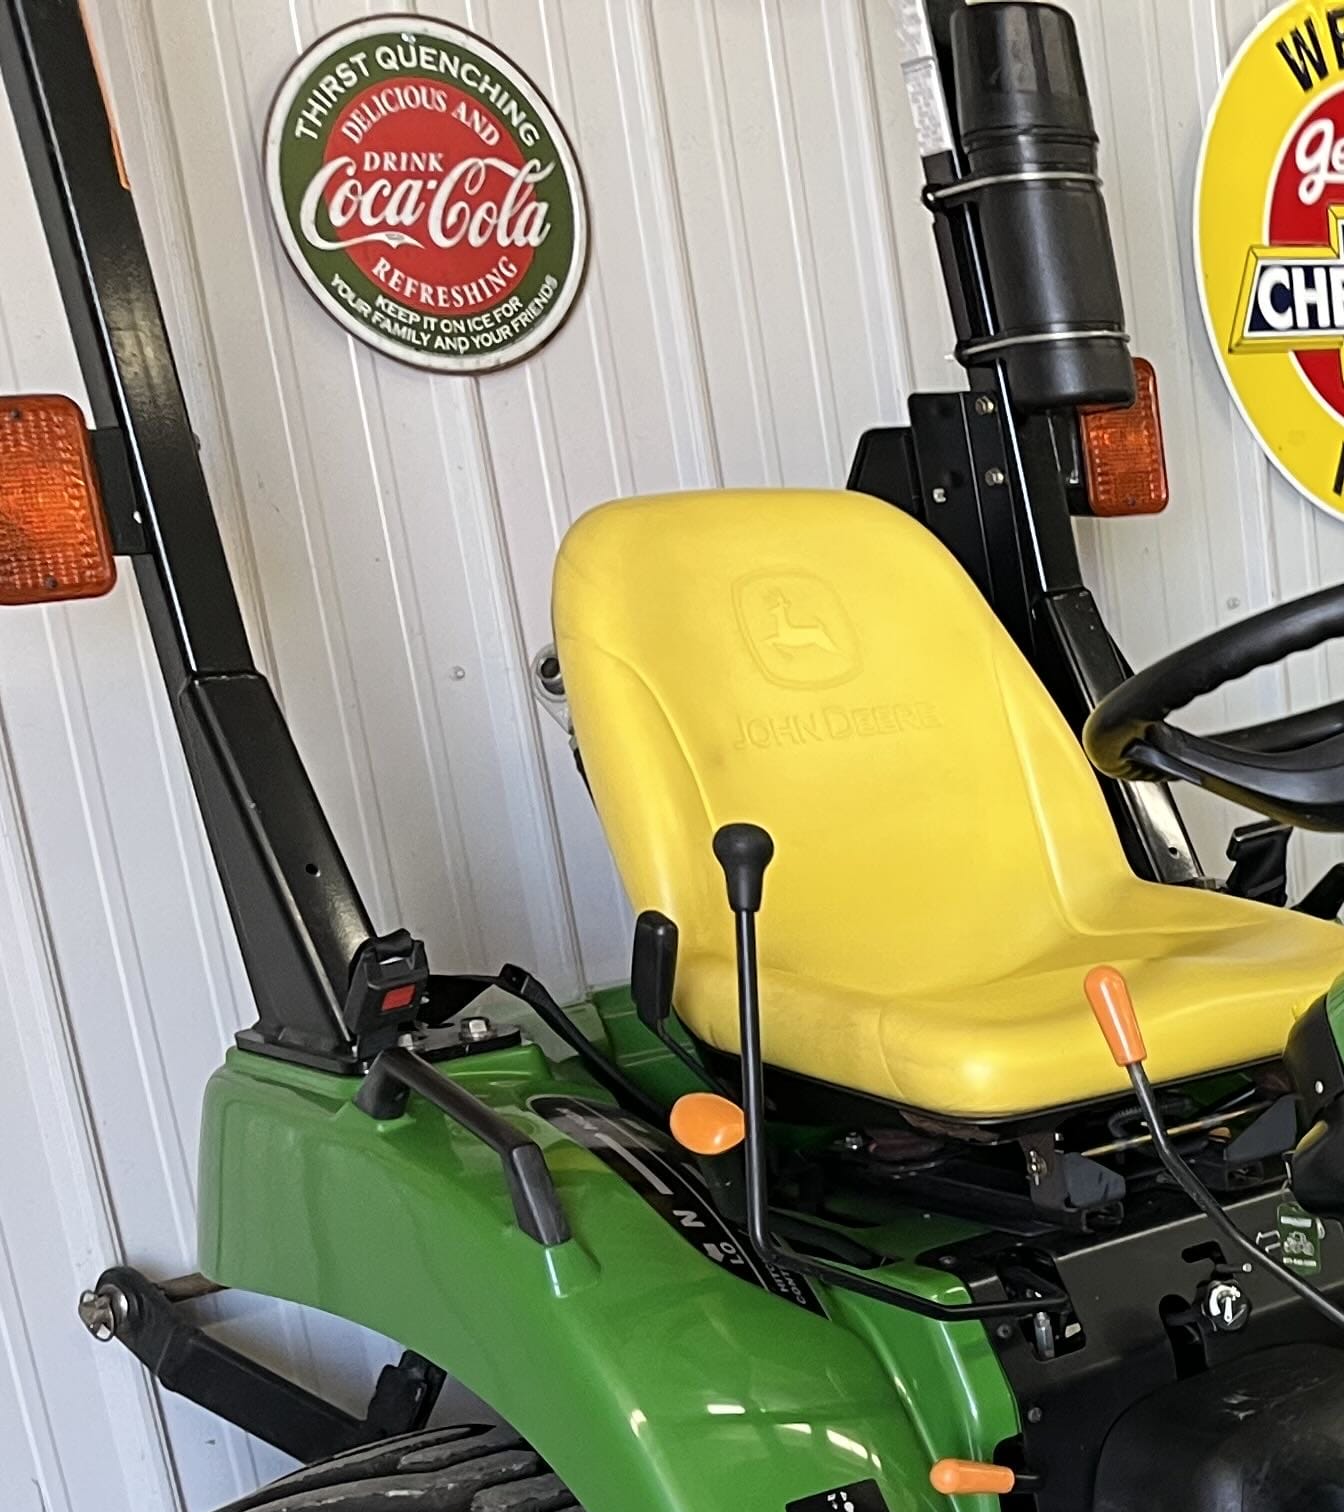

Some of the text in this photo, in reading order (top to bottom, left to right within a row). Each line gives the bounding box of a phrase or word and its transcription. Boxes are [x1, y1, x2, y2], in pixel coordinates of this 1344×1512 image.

[295, 44, 540, 148] THIRST QUENCHING
[341, 85, 501, 147] DELICIOUS AND
[363, 151, 445, 172] DRINK
[300, 155, 556, 250] Coca-Cola
[372, 255, 519, 309] REFRESHING
[331, 273, 559, 353] YOUR FAMILY AND YOUR FRIENDS
[375, 294, 524, 334] KEEP IT ON ICE FOR
[734, 702, 943, 750] JOHN DEERE
